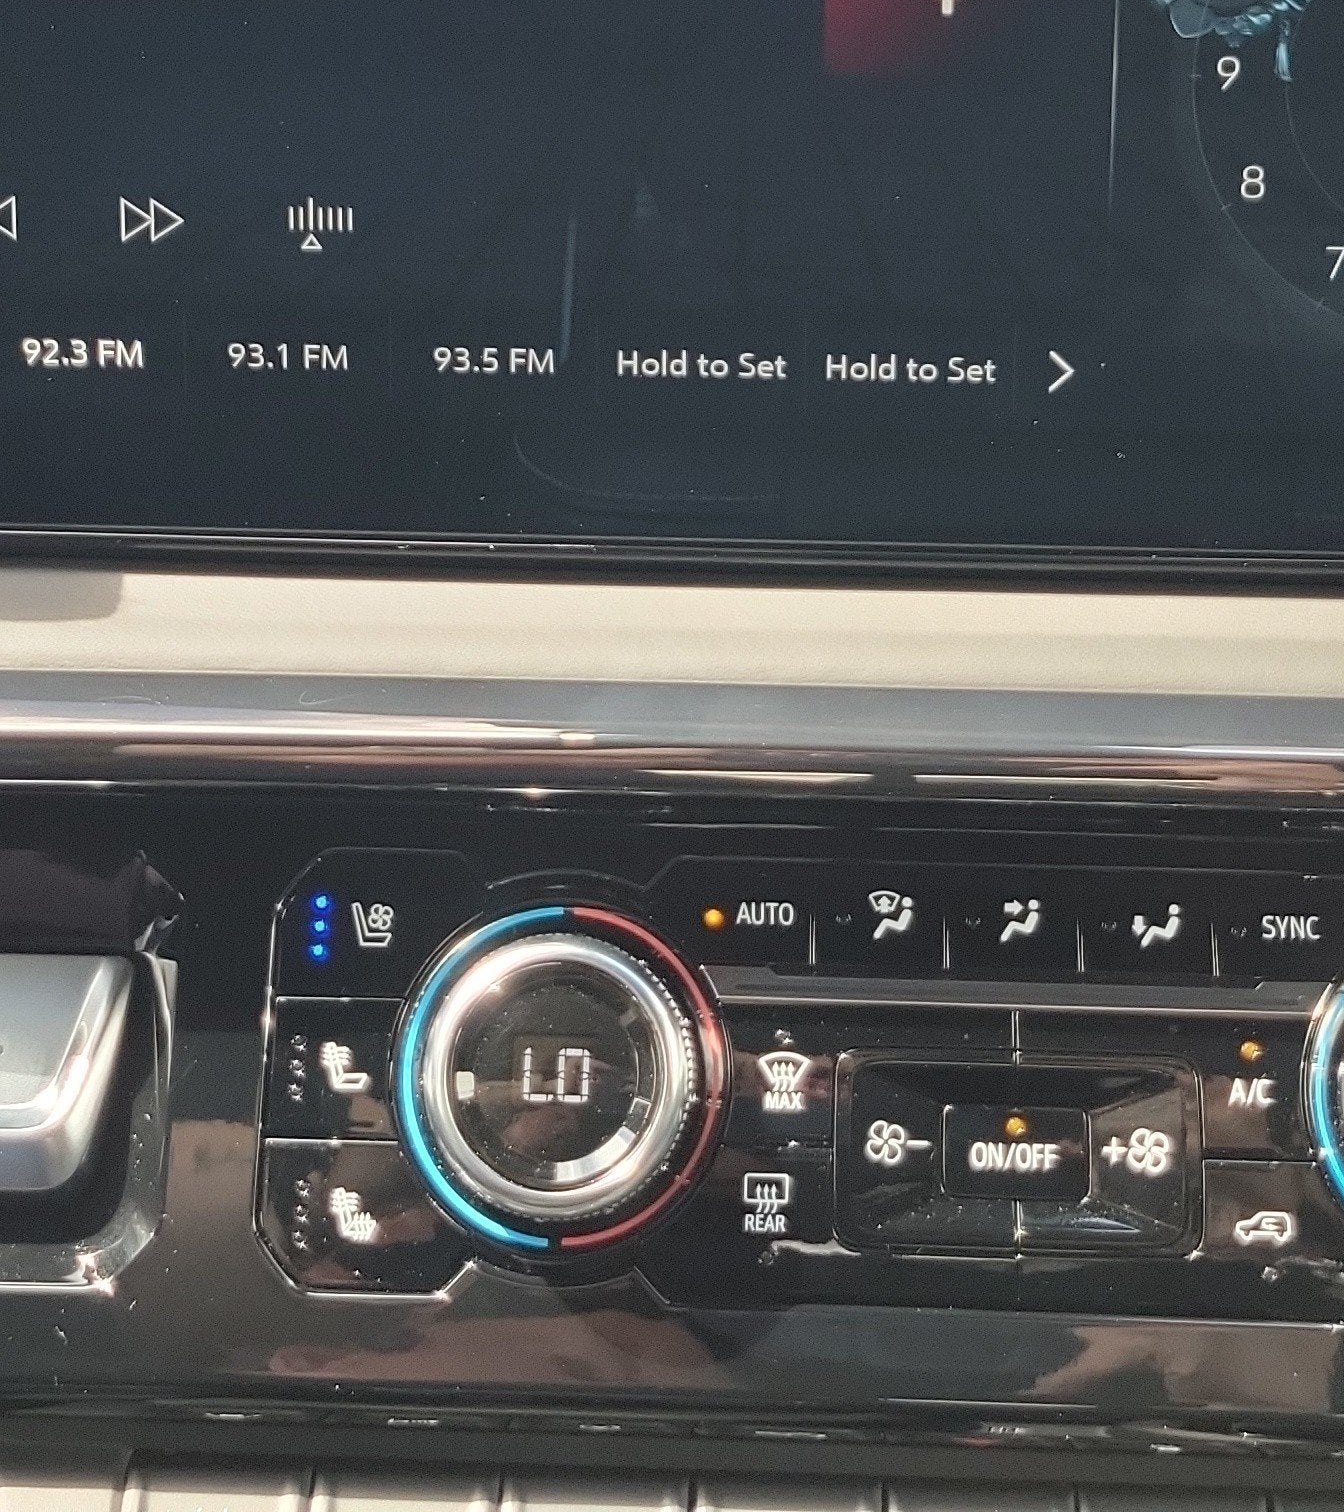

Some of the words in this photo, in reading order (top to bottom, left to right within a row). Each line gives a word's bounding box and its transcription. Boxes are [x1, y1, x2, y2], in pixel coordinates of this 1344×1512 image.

[1216, 56, 1241, 90] 9
[1240, 165, 1265, 199] 8
[22, 337, 88, 367] 92.3
[97, 339, 144, 368] FM
[228, 343, 288, 369] 93.1
[303, 344, 348, 371] FM
[433, 346, 499, 374] 93.5
[510, 347, 555, 373] FM
[617, 349, 687, 377] Hold
[696, 353, 729, 378] to
[738, 352, 787, 379] Set
[826, 353, 897, 382] Hold
[906, 358, 938, 382] to
[947, 356, 997, 382] Set
[736, 901, 794, 926] AUTO
[1262, 915, 1321, 940] SYNC
[764, 1091, 803, 1110] MAX
[1227, 1077, 1274, 1107] A/C
[970, 1141, 1059, 1170] ON/OFF
[744, 1213, 786, 1233] REAR
